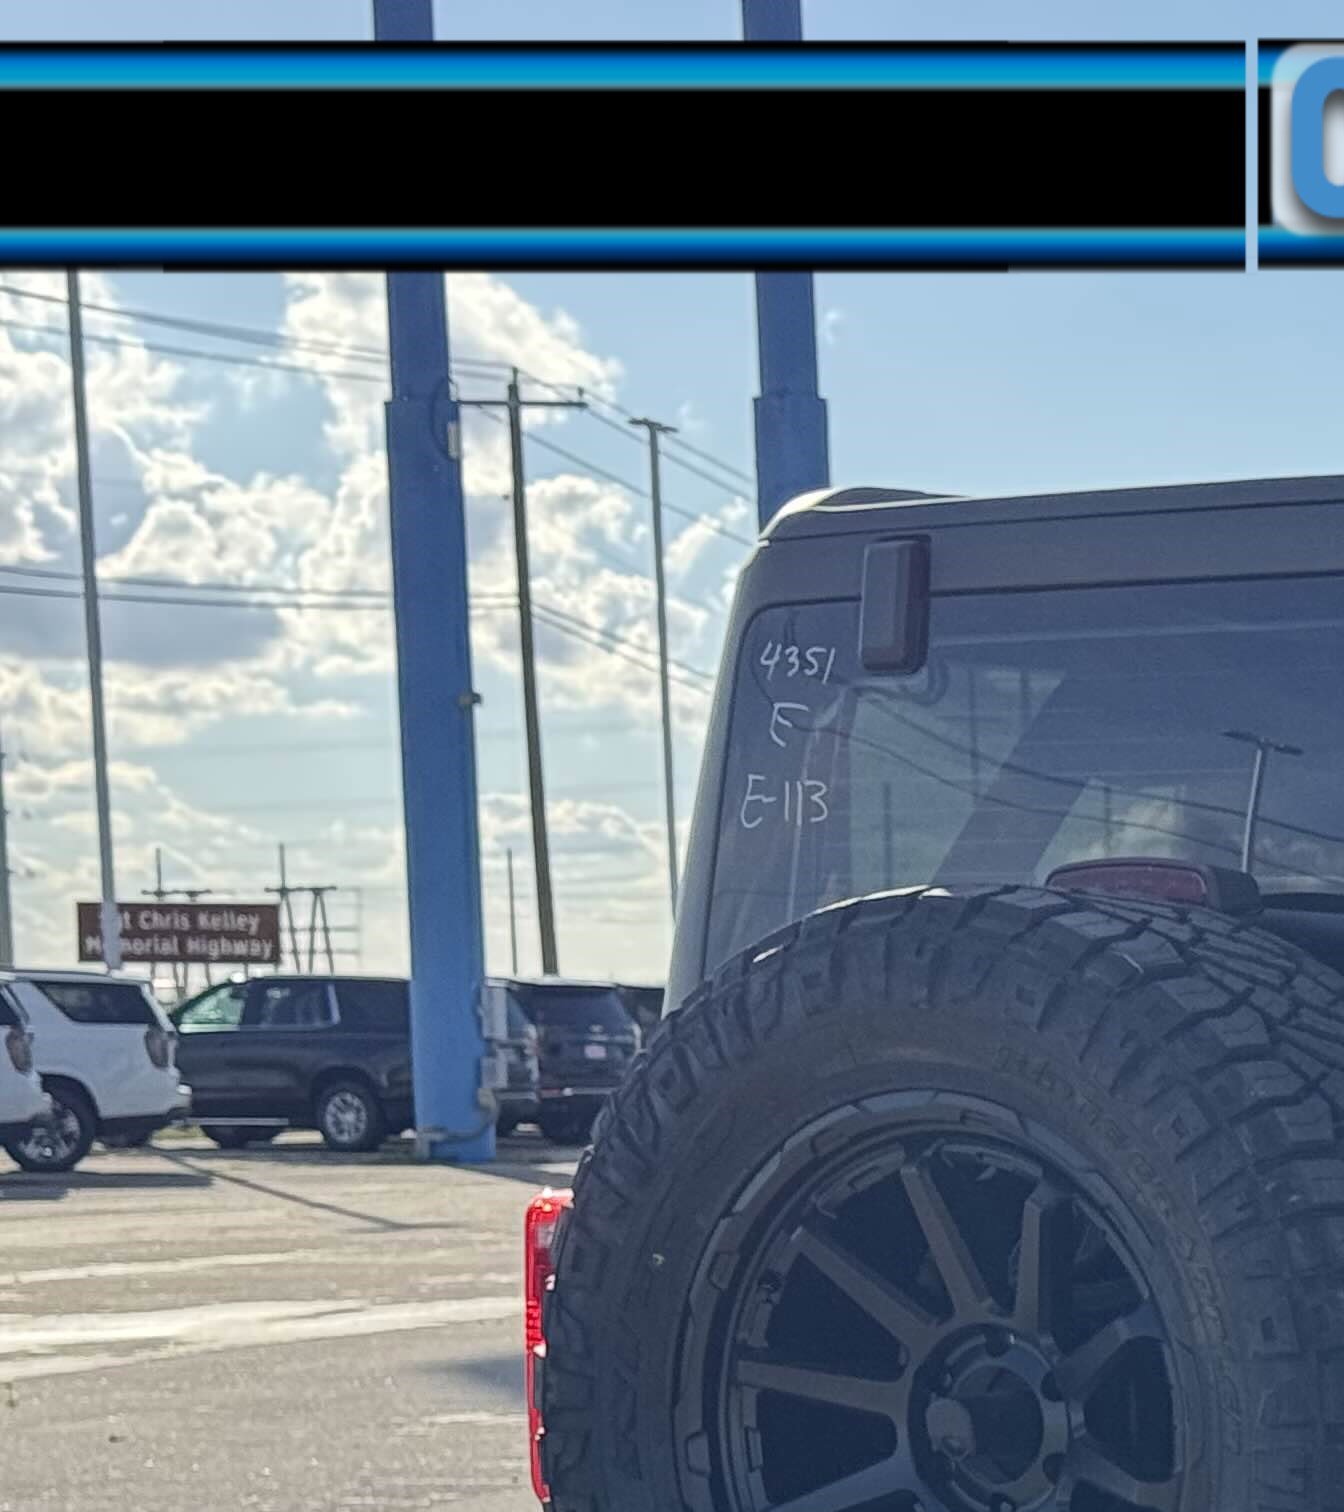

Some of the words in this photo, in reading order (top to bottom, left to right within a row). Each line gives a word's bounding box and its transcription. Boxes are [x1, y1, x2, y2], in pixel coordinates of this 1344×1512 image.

[760, 640, 836, 685] 4351
[139, 909, 192, 932] Chris
[198, 910, 260, 936] Kelley
[185, 937, 273, 961] Highway
